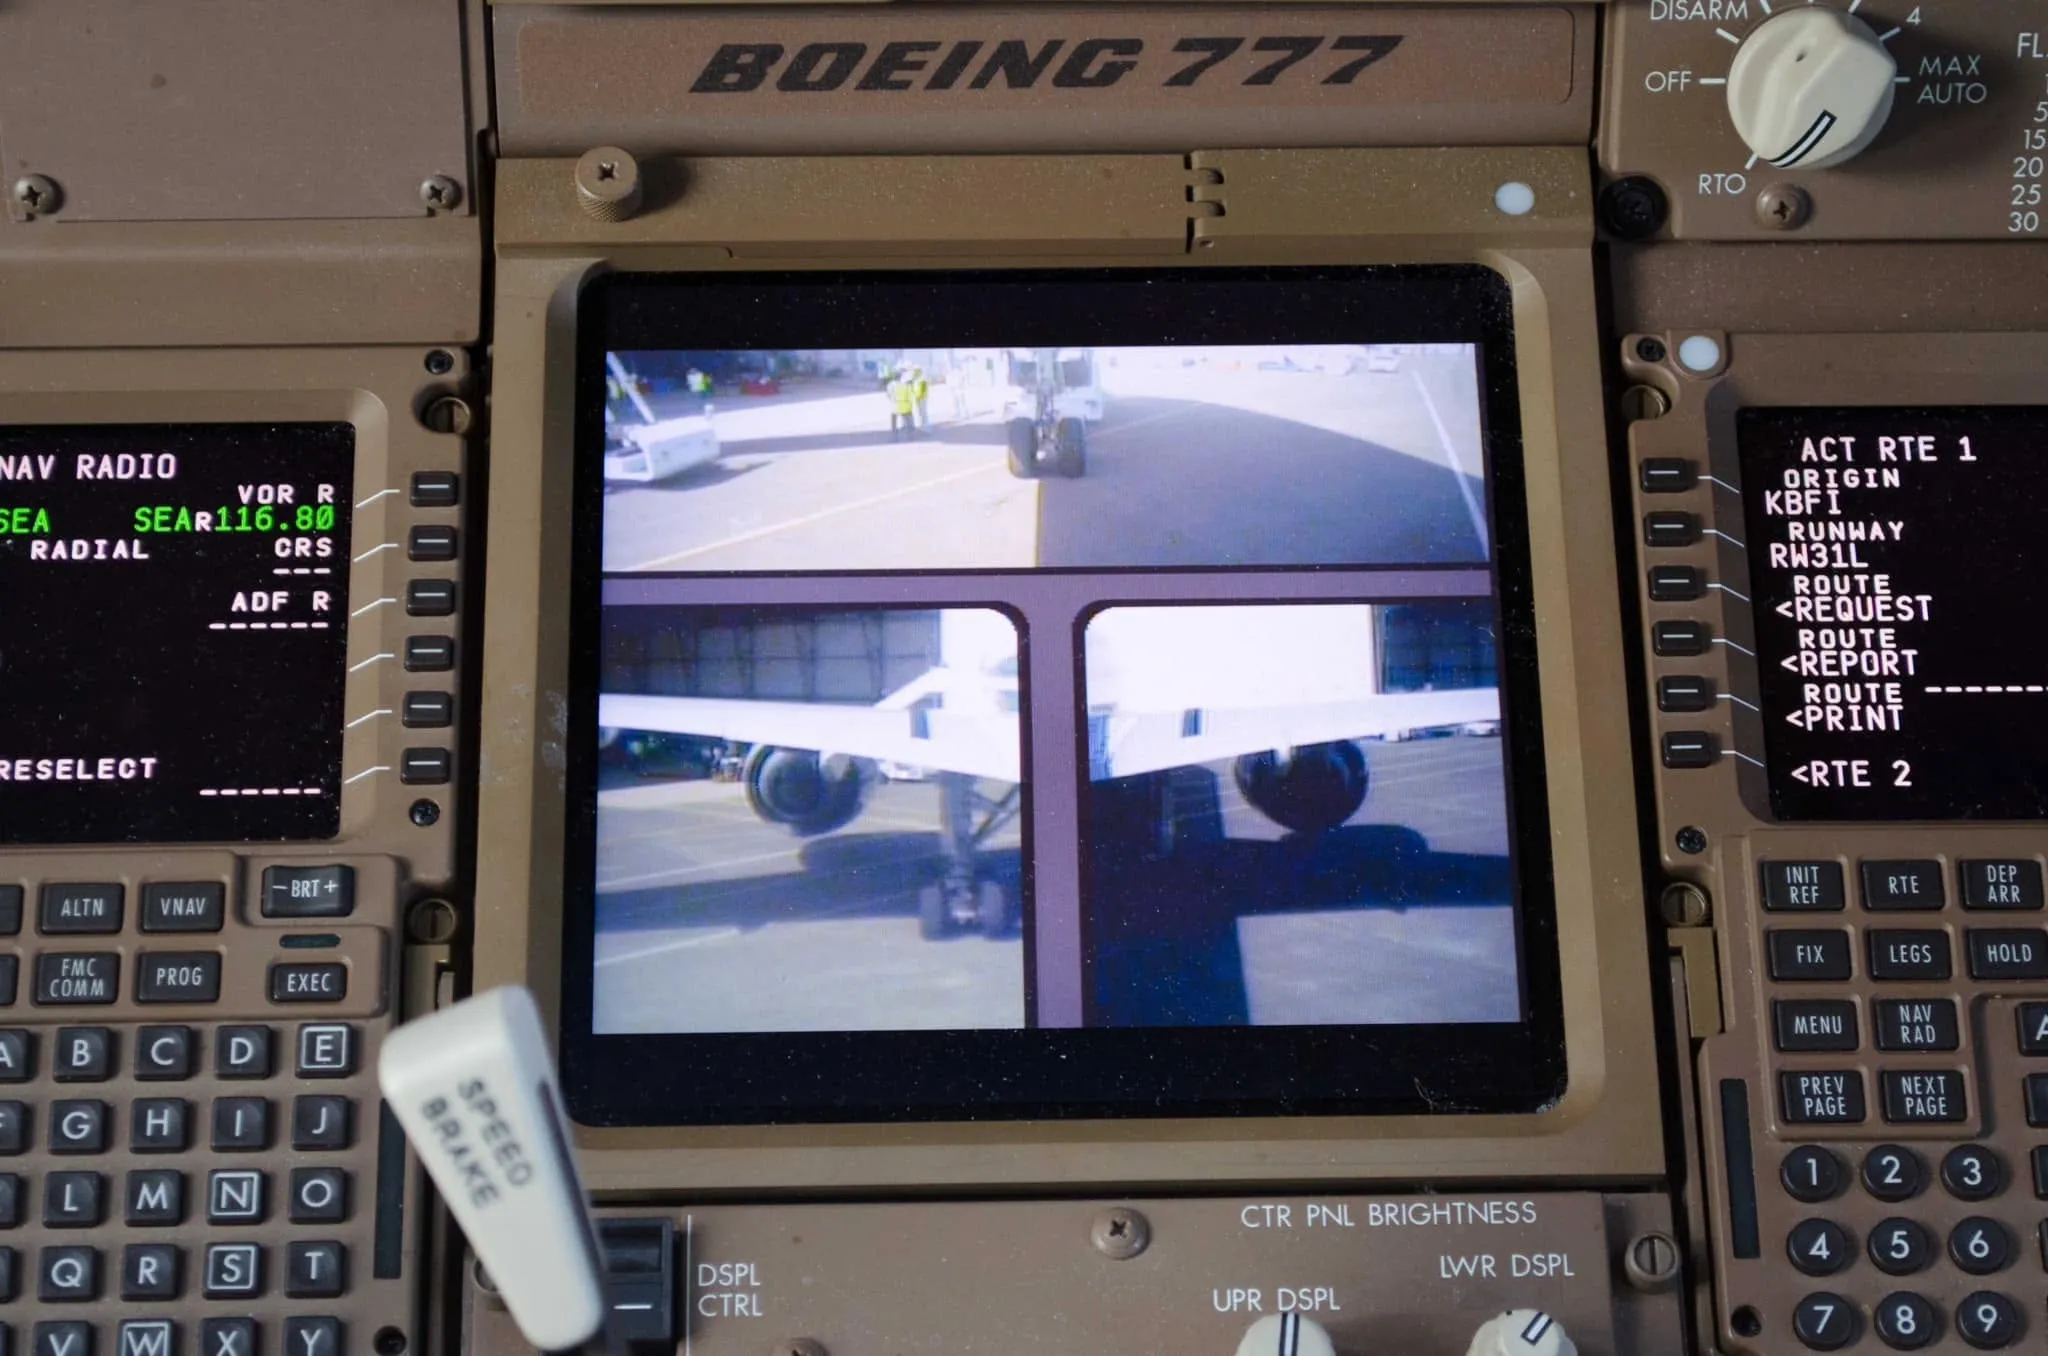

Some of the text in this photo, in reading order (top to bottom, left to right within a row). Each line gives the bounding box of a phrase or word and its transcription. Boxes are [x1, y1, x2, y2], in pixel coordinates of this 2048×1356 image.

[1650, 0, 1748, 21] DISARM
[1906, 5, 1921, 25] 4
[2016, 32, 2048, 59] FL
[688, 34, 1405, 94] BOEING 777
[1919, 54, 1981, 76] MAX
[1645, 70, 1692, 92] OFF
[1917, 82, 1987, 104] AUTO
[2033, 101, 2048, 123] 5
[2023, 128, 2046, 150] 15
[2013, 156, 2044, 178] 20
[1698, 173, 1746, 195] RTO
[2011, 183, 2041, 206] 25
[2007, 211, 2039, 233] 30
[1801, 435, 1977, 462] ACT RTE 1
[0, 453, 176, 480] NAV RADIO
[1784, 467, 1900, 489] ORIGIN
[237, 483, 334, 505] VOR R
[1765, 488, 1842, 515] KBFI
[0, 507, 50, 534] SEA
[1788, 520, 1904, 542] RUNWAY
[30, 539, 149, 560] RADIAL
[274, 536, 332, 558] CRS
[1770, 542, 1869, 569] RW31L
[1793, 574, 1891, 595] ROUTE
[231, 590, 331, 612] ADF R
[1798, 628, 1897, 649] ROUTE
[1803, 682, 1903, 704] ROUTE
[1892, 759, 1912, 787] 2
[1786, 865, 1819, 884] INIT
[1888, 875, 1919, 894] RTE
[1986, 864, 2017, 883] DEP
[1789, 885, 1819, 904] REF
[1988, 884, 2021, 903] ARR
[60, 898, 104, 917] ALTN
[160, 897, 206, 916] VNAV
[1796, 945, 1824, 963] FIX
[1890, 944, 1932, 963] LEGS
[1987, 943, 2032, 963] HOLD
[61, 958, 96, 977] FMC
[156, 966, 202, 986] PROG
[50, 978, 104, 998] COMM
[287, 972, 331, 993] EXEC
[1794, 1015, 1842, 1035] MENU
[1899, 1004, 1932, 1023] NAV
[1900, 1024, 1936, 1043] RAD
[71, 1039, 91, 1066] B
[150, 1037, 176, 1066] C
[230, 1037, 254, 1065] D
[315, 1034, 335, 1063] E
[1800, 1076, 1844, 1096] PREV
[1901, 1075, 1945, 1095] NEXT
[1804, 1096, 1847, 1116] PAGE
[1905, 1096, 1947, 1116] PAGE
[62, 1110, 91, 1140] G
[146, 1108, 170, 1137] H
[234, 1109, 243, 1137] I
[311, 1106, 328, 1135] J
[457, 1078, 534, 1188] SPEED
[421, 1096, 500, 1209] BRAKE
[1807, 1158, 1817, 1186] 1
[1881, 1155, 1902, 1184] 2
[1962, 1157, 1982, 1186] 3
[63, 1183, 78, 1212] L
[136, 1181, 168, 1210] M
[220, 1180, 249, 1209] N
[301, 1178, 333, 1208] O
[1240, 1200, 1537, 1228] CTR PNL BRIGHTNESS
[1809, 1232, 1830, 1260] 4
[1890, 1230, 1910, 1259] 5
[1968, 1229, 1989, 1258] 6
[51, 1257, 84, 1288] Q
[138, 1256, 158, 1285] R
[221, 1253, 242, 1283] S
[304, 1250, 325, 1280] T
[698, 1262, 761, 1287] DSPL
[1440, 1253, 1575, 1279] LWR DSPL
[698, 1292, 763, 1317] CTRL
[1213, 1287, 1341, 1312] UPR DSPL
[1813, 1305, 1834, 1334] 7
[1895, 1305, 1916, 1334] 8
[1977, 1304, 1998, 1333] 9
[49, 1333, 76, 1356] V
[126, 1329, 166, 1356] W
[216, 1330, 239, 1356] X
[300, 1328, 323, 1356] Y
